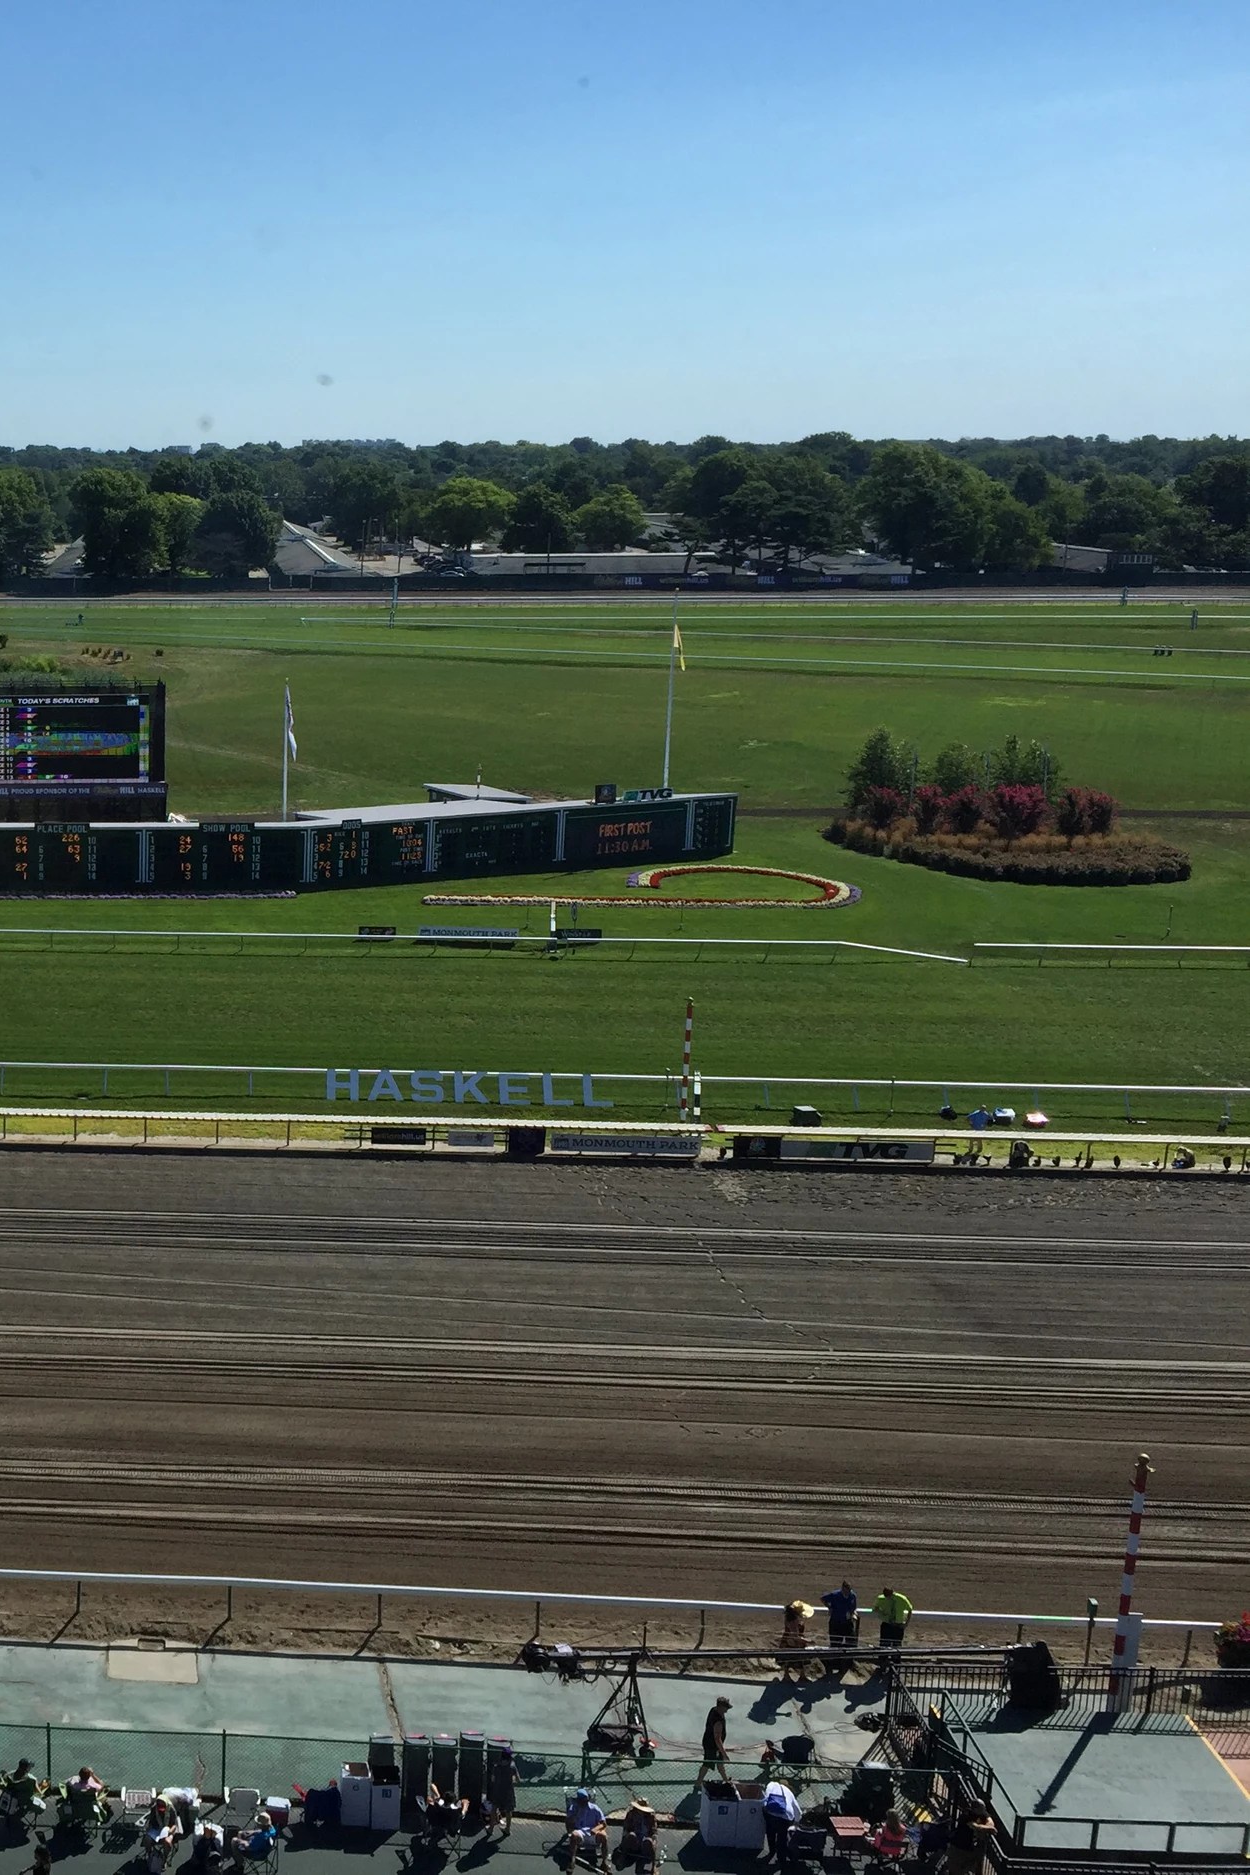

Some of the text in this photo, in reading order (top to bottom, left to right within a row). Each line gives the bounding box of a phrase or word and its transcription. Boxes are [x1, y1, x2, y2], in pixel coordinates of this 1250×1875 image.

[119, 786, 135, 794] HILL
[639, 788, 672, 800] TVG
[37, 825, 87, 833] PLACE POOL
[202, 824, 250, 832] SHOW POOL
[342, 821, 361, 830] ODDS
[599, 820, 652, 838] FIRST POST
[392, 826, 414, 835] FAST
[15, 836, 28, 844] 62
[62, 834, 80, 842] 226
[88, 836, 96, 844] 10
[179, 836, 191, 844] 24
[228, 833, 245, 842] 148
[252, 836, 261, 844] 10
[326, 833, 333, 842] 3
[362, 831, 370, 840] 10
[15, 845, 28, 853] 64
[68, 845, 80, 853] 63
[179, 845, 191, 853] 27
[232, 845, 244, 853] 56
[252, 845, 261, 853] 11
[339, 842, 344, 850] 6
[361, 840, 369, 848] 11
[596, 841, 629, 856] 11:30
[361, 849, 369, 857] 12
[234, 854, 244, 862] 19
[252, 854, 261, 862] 12
[361, 858, 368, 866] 13
[15, 863, 28, 871] 27
[181, 863, 191, 871] 19
[252, 863, 261, 871] 13
[185, 872, 191, 880] 3
[252, 872, 261, 880] 14
[325, 870, 331, 878] 6
[360, 867, 368, 875] 14
[432, 928, 518, 938] MONMOUTH PARK
[326, 1068, 614, 1108] HASKELL
[571, 1138, 699, 1151] MONMOUTH PARK
[838, 1143, 909, 1159] TVG
